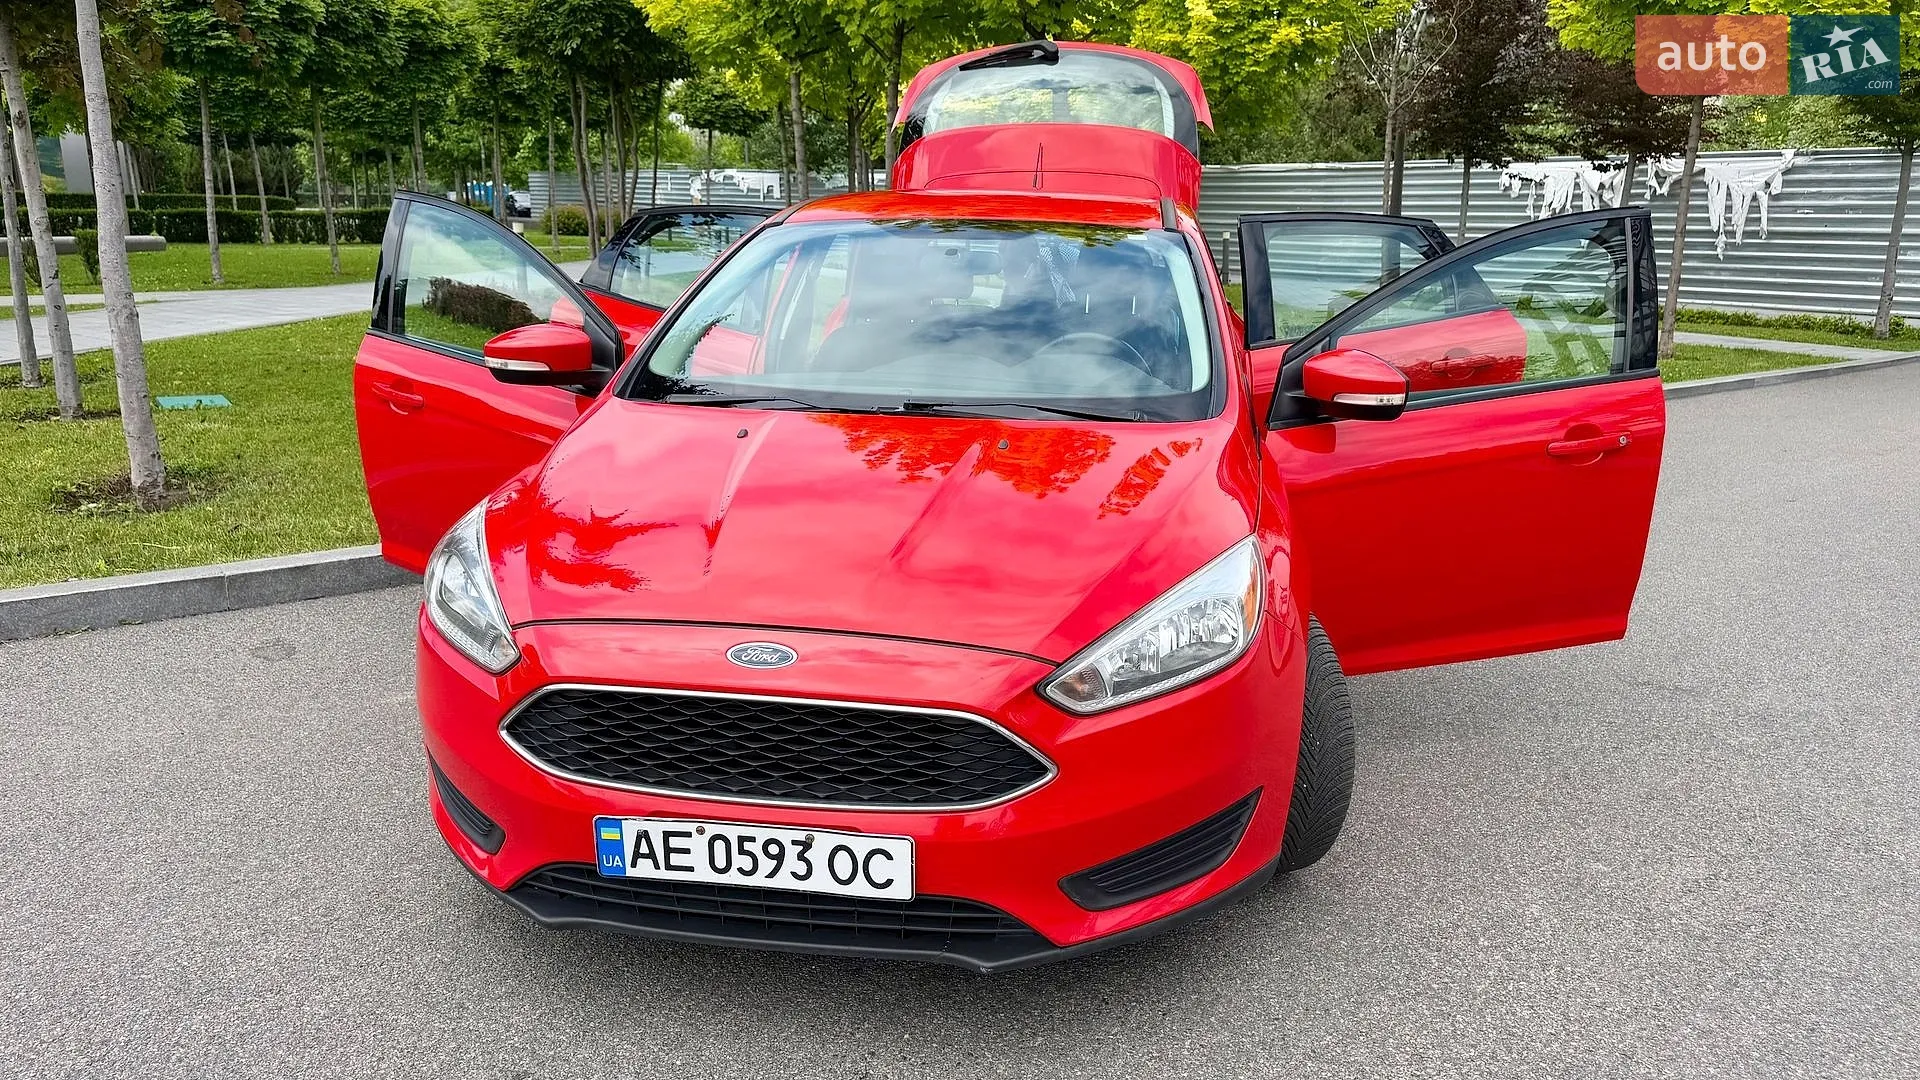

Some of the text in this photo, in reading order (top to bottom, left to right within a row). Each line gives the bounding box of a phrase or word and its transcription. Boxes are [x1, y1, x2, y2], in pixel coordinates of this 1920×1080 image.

[741, 646, 782, 663] Ford
[602, 853, 624, 868] UA
[630, 829, 894, 890] AE 0593 OC
